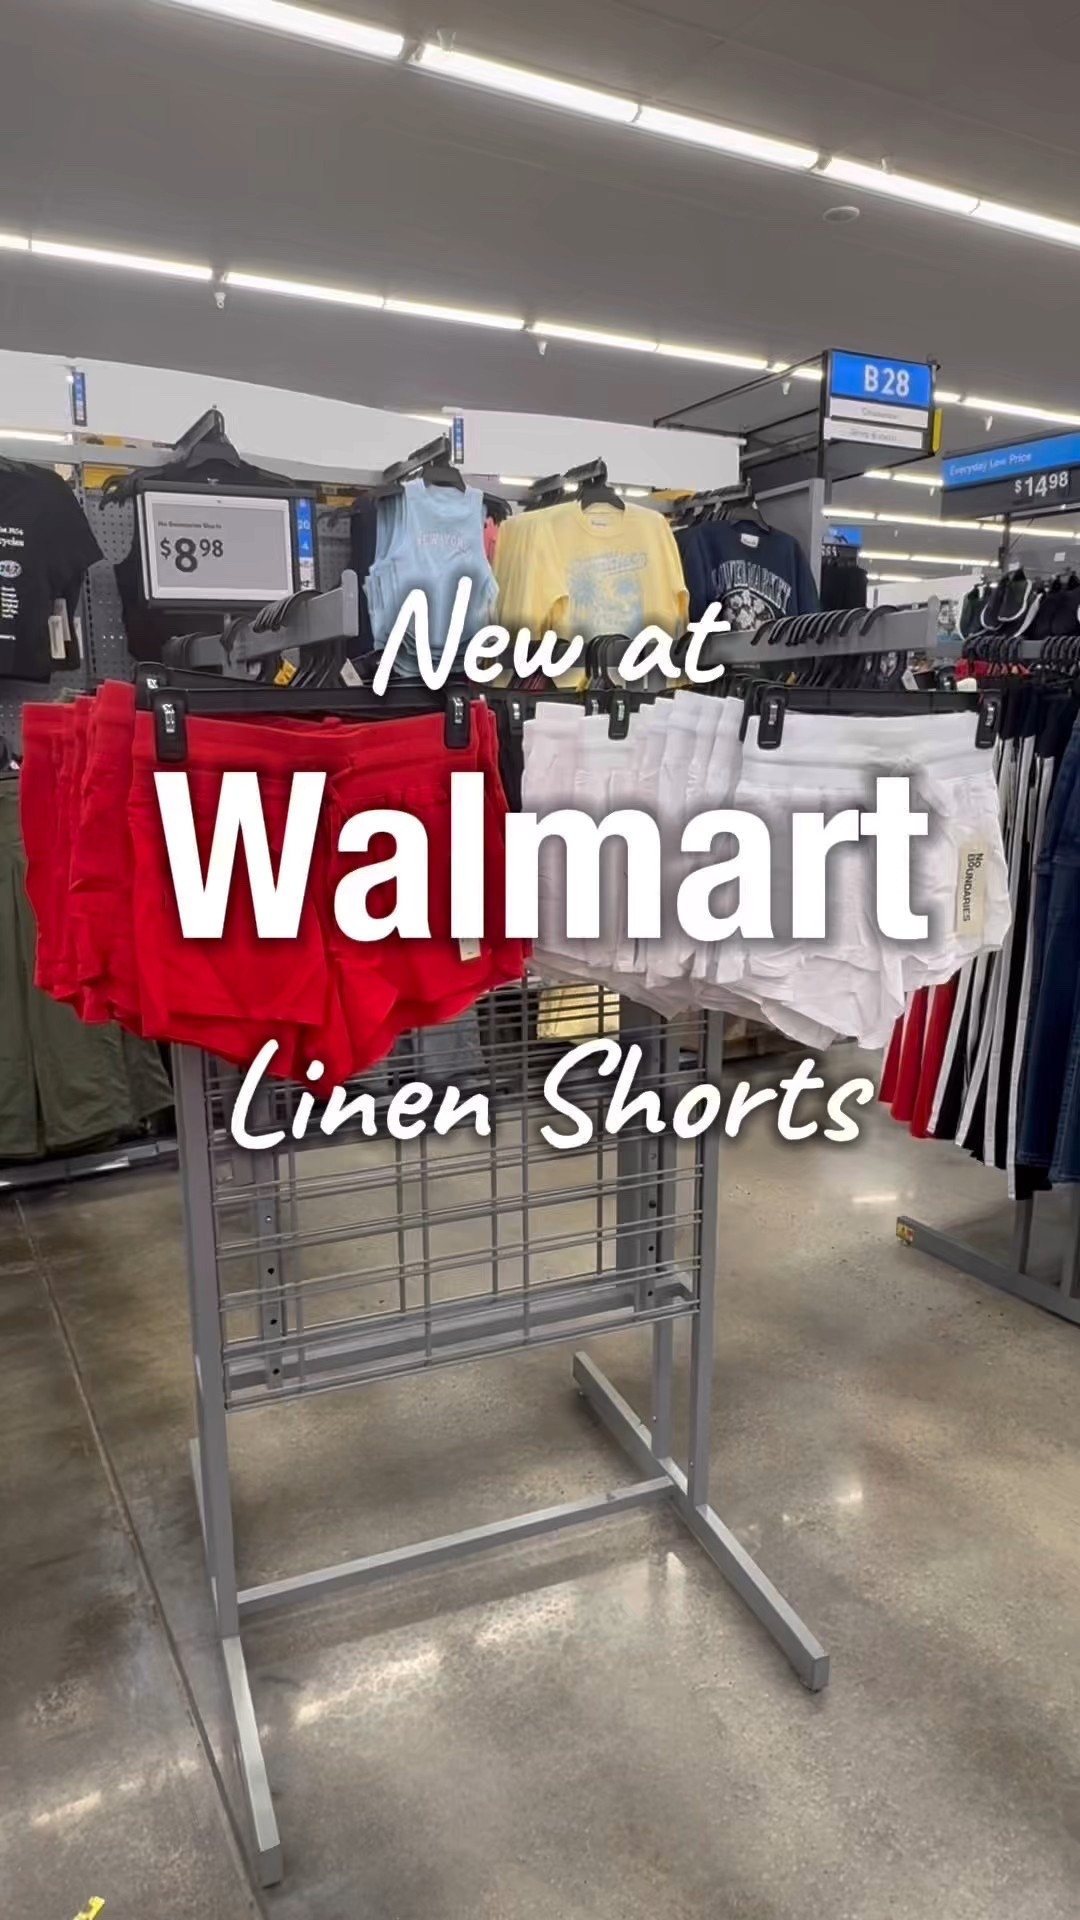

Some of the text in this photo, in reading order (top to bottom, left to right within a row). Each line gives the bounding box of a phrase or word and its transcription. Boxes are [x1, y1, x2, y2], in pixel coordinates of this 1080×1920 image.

[864, 364, 910, 397] B28
[949, 461, 988, 476] Everyday
[1008, 453, 1032, 465] Price
